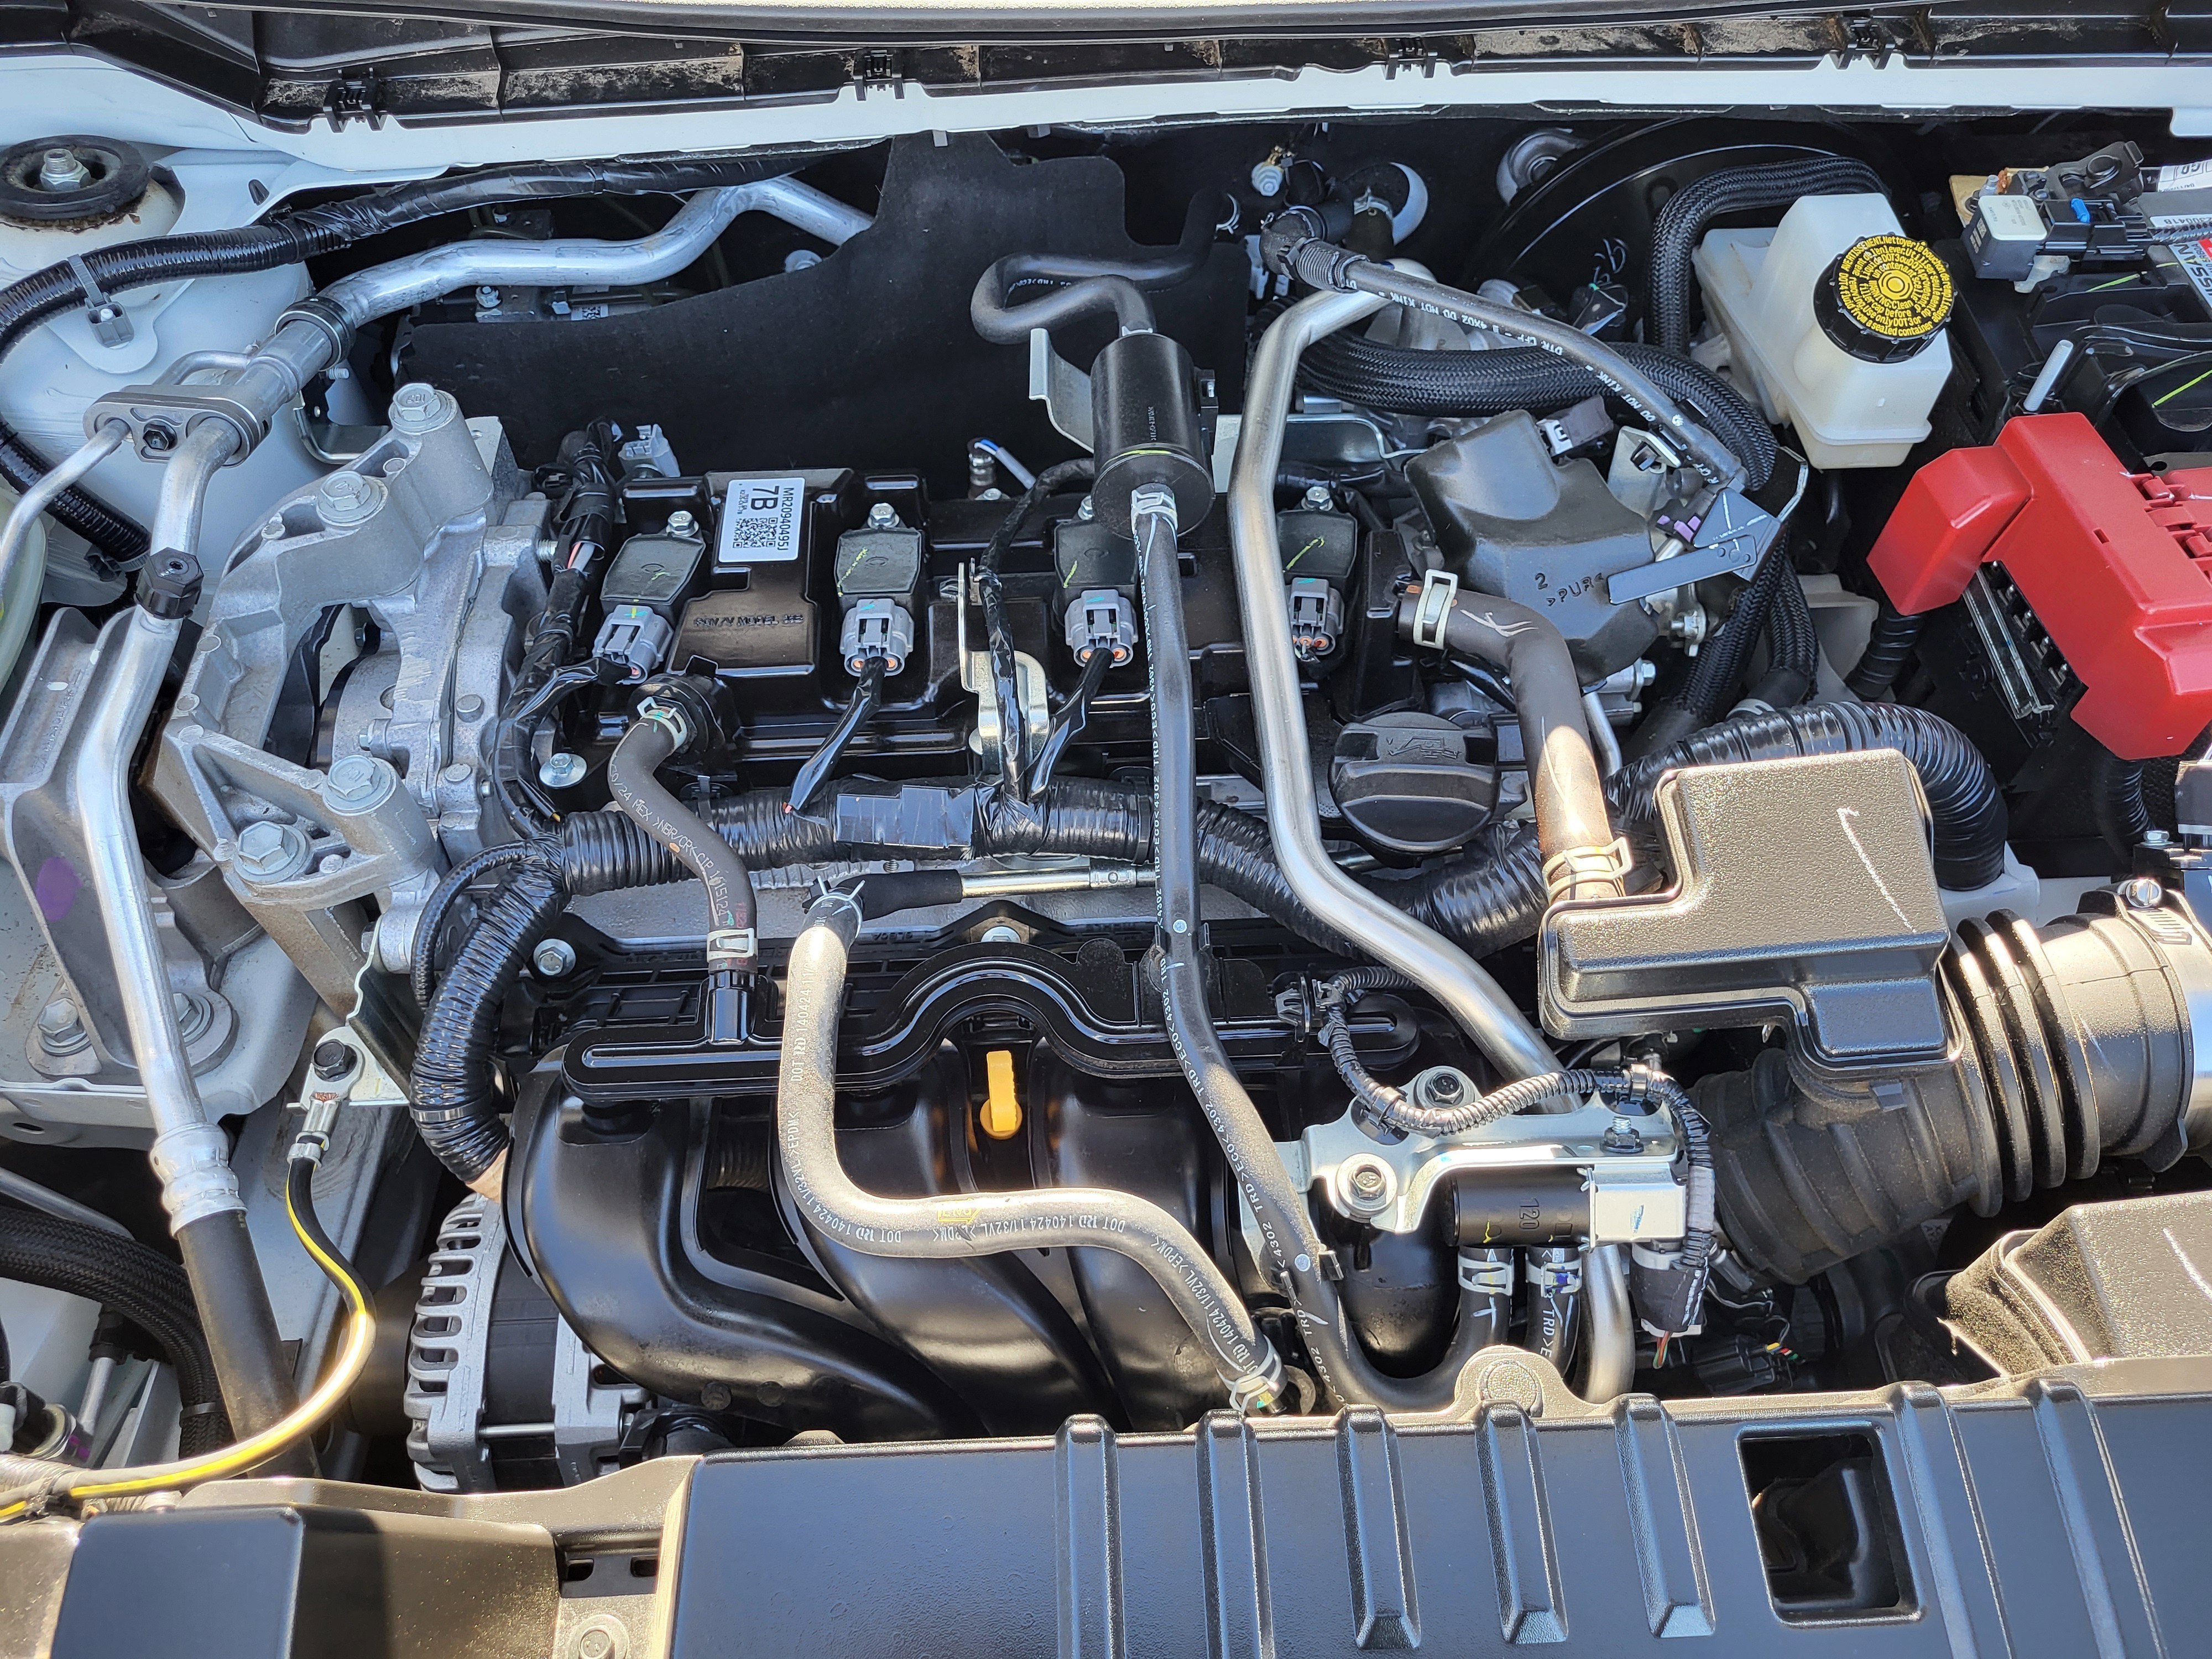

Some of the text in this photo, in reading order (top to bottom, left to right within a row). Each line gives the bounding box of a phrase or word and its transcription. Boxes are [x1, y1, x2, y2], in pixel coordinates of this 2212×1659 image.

[1914, 243, 1924, 252] le
[1851, 258, 1867, 276] avant
[1859, 256, 1883, 280] liquide
[1872, 269, 1882, 279] un
[1879, 261, 1917, 278] contenant
[1922, 248, 1946, 274] bouchon
[1940, 273, 1950, 281] de
[1390, 291, 1416, 308] KINK
[1859, 283, 1912, 318] filler cap before
[1927, 275, 1943, 311] seulement
[1932, 281, 1953, 323] remplissage
[1420, 301, 1439, 315] NOT
[1838, 272, 1933, 337] DOT4 fluid from a sealed container
[1921, 308, 1932, 318] du
[1596, 371, 1623, 393] KINK
[1621, 393, 1642, 410] NOT
[750, 486, 780, 510] 7B
[777, 487, 795, 551] MR20940495J
[1535, 572, 1548, 590] 2
[632, 798, 653, 822] MEX
[697, 852, 714, 869] CIP
[795, 989, 812, 1032] 140424
[791, 1062, 803, 1082] DOT
[812, 1202, 852, 1236] 140424
[1029, 1214, 1073, 1232] 140424
[1102, 1215, 1126, 1234] DOT
[1519, 1197, 1540, 1231] 120
[879, 1228, 902, 1243] DOT
[979, 1218, 1025, 1238] 11/32VL
[1185, 1269, 1215, 1310] 11/32VL
[1208, 1307, 1239, 1345] 140424
